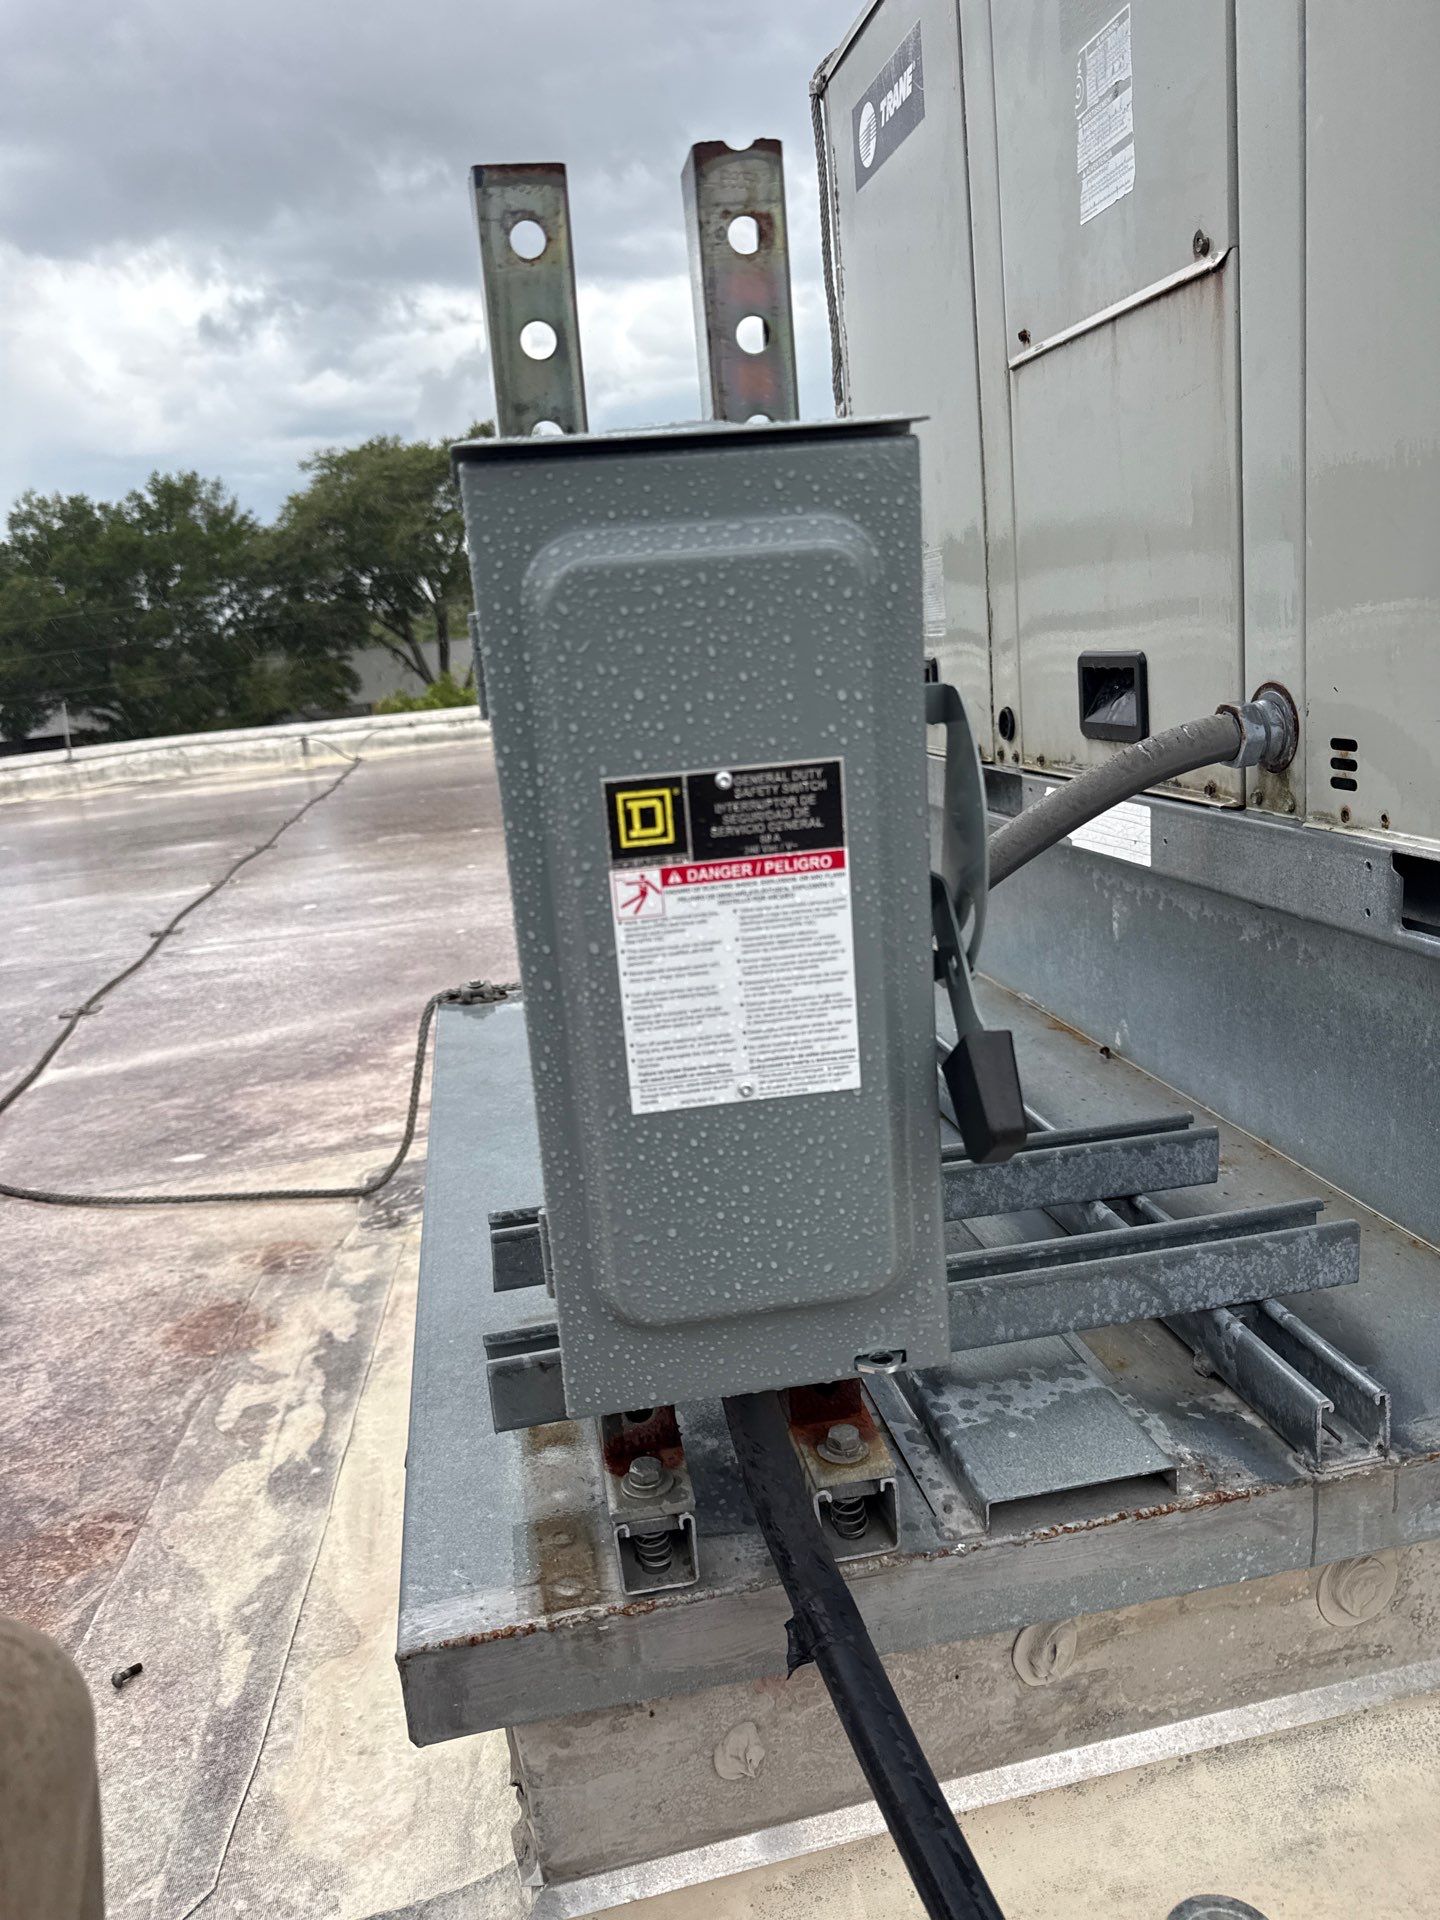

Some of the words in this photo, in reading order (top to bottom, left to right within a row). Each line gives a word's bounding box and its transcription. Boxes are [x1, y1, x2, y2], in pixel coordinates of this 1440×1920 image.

[880, 62, 913, 128] TRANE
[733, 772, 790, 787] GENERAL
[791, 767, 824, 782] DUTY
[734, 784, 780, 799] SAFETY
[781, 779, 828, 794] SWITCH
[767, 817, 825, 833] GENERAL
[686, 863, 754, 883] DANGER
[755, 861, 761, 875] /
[764, 855, 833, 874] PELIGRO
